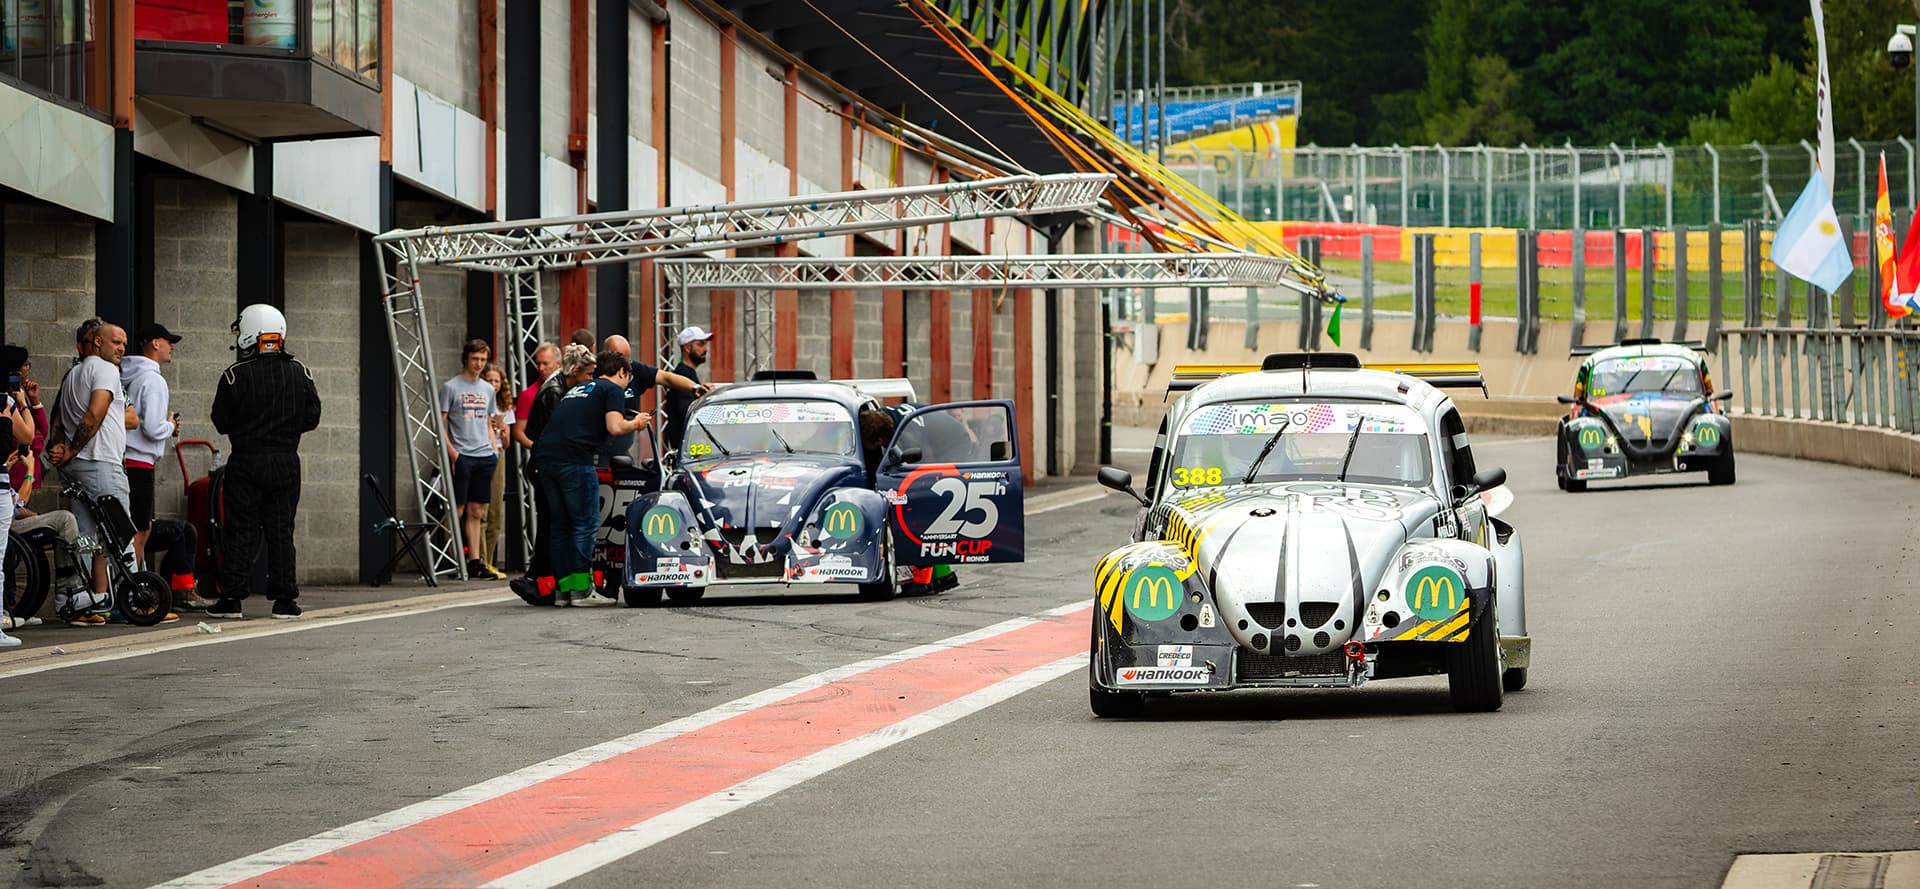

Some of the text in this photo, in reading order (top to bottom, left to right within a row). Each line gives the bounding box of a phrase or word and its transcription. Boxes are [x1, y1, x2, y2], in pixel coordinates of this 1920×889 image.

[722, 407, 772, 419] imao
[1232, 409, 1308, 426] imao
[689, 443, 712, 456] 325
[1173, 466, 1223, 486] 388
[1158, 652, 1192, 660] CREDECO
